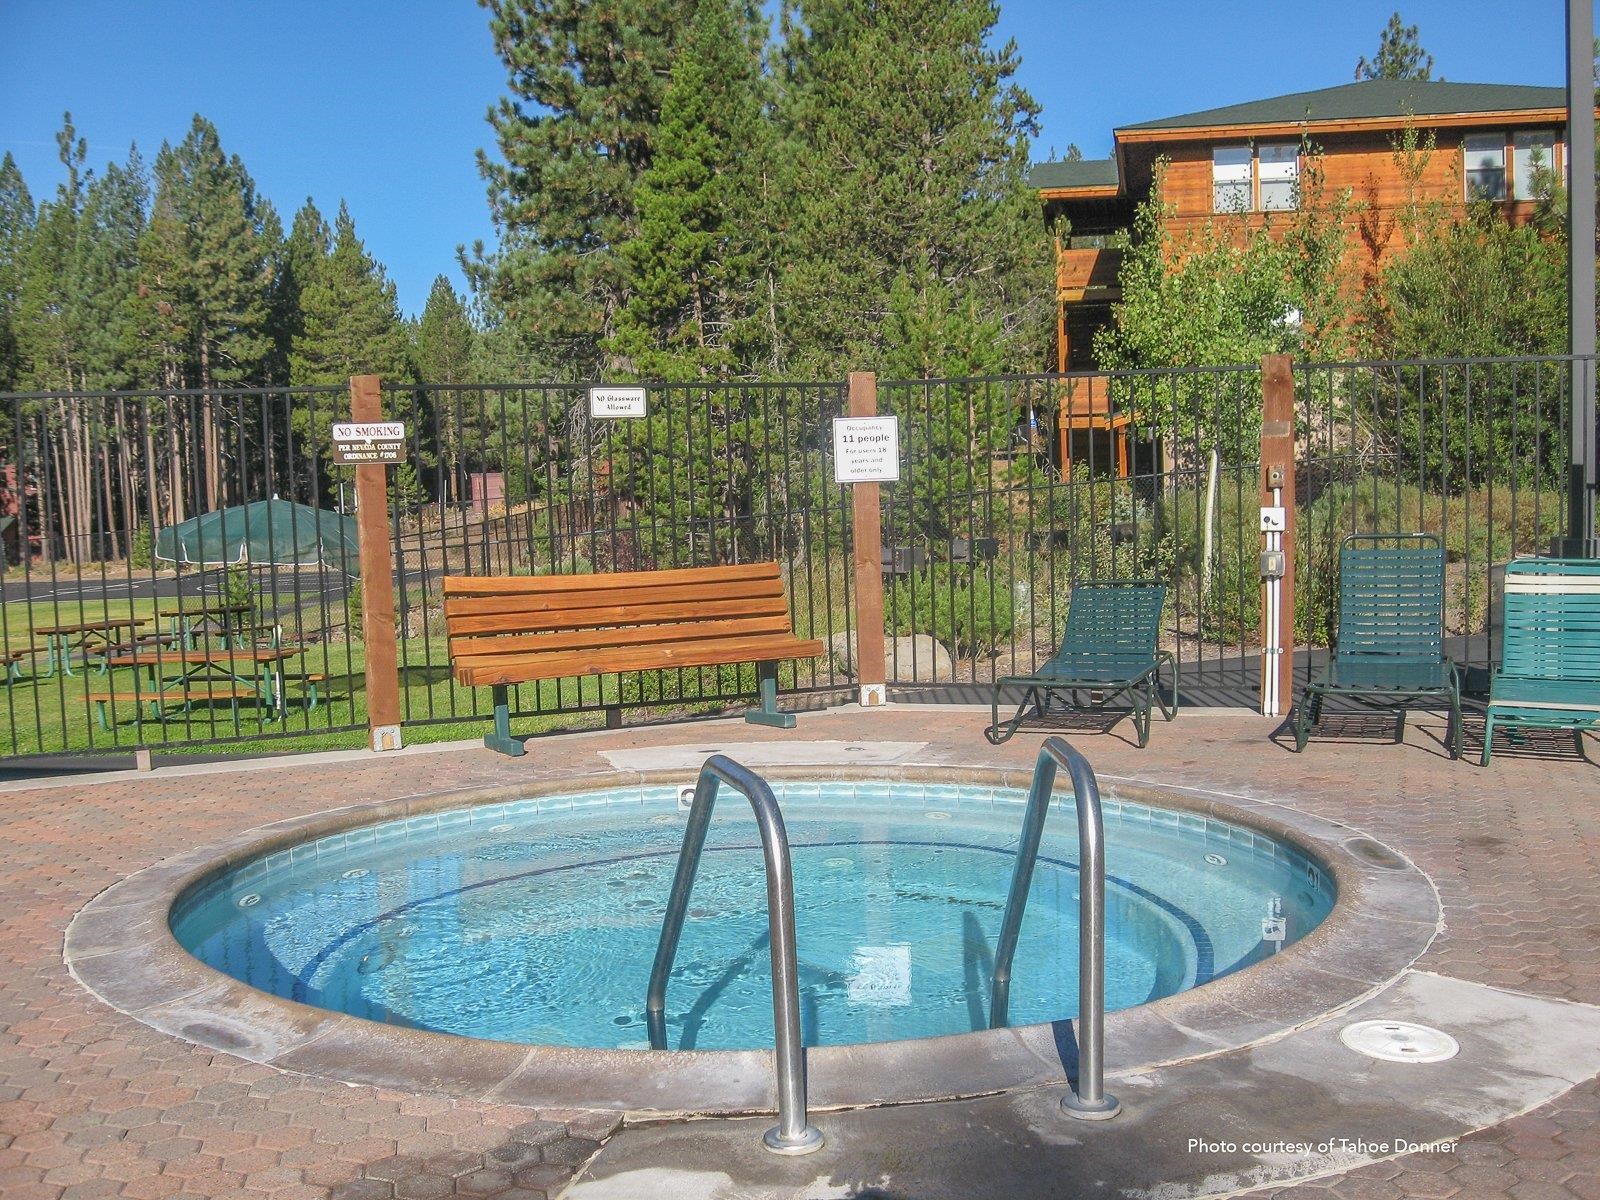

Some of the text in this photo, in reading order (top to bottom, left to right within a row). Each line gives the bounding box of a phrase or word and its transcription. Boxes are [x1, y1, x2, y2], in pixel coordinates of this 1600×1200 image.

[607, 394, 641, 402] Glassware
[338, 426, 400, 436] NO SMOKING
[842, 434, 890, 443] 11 people
